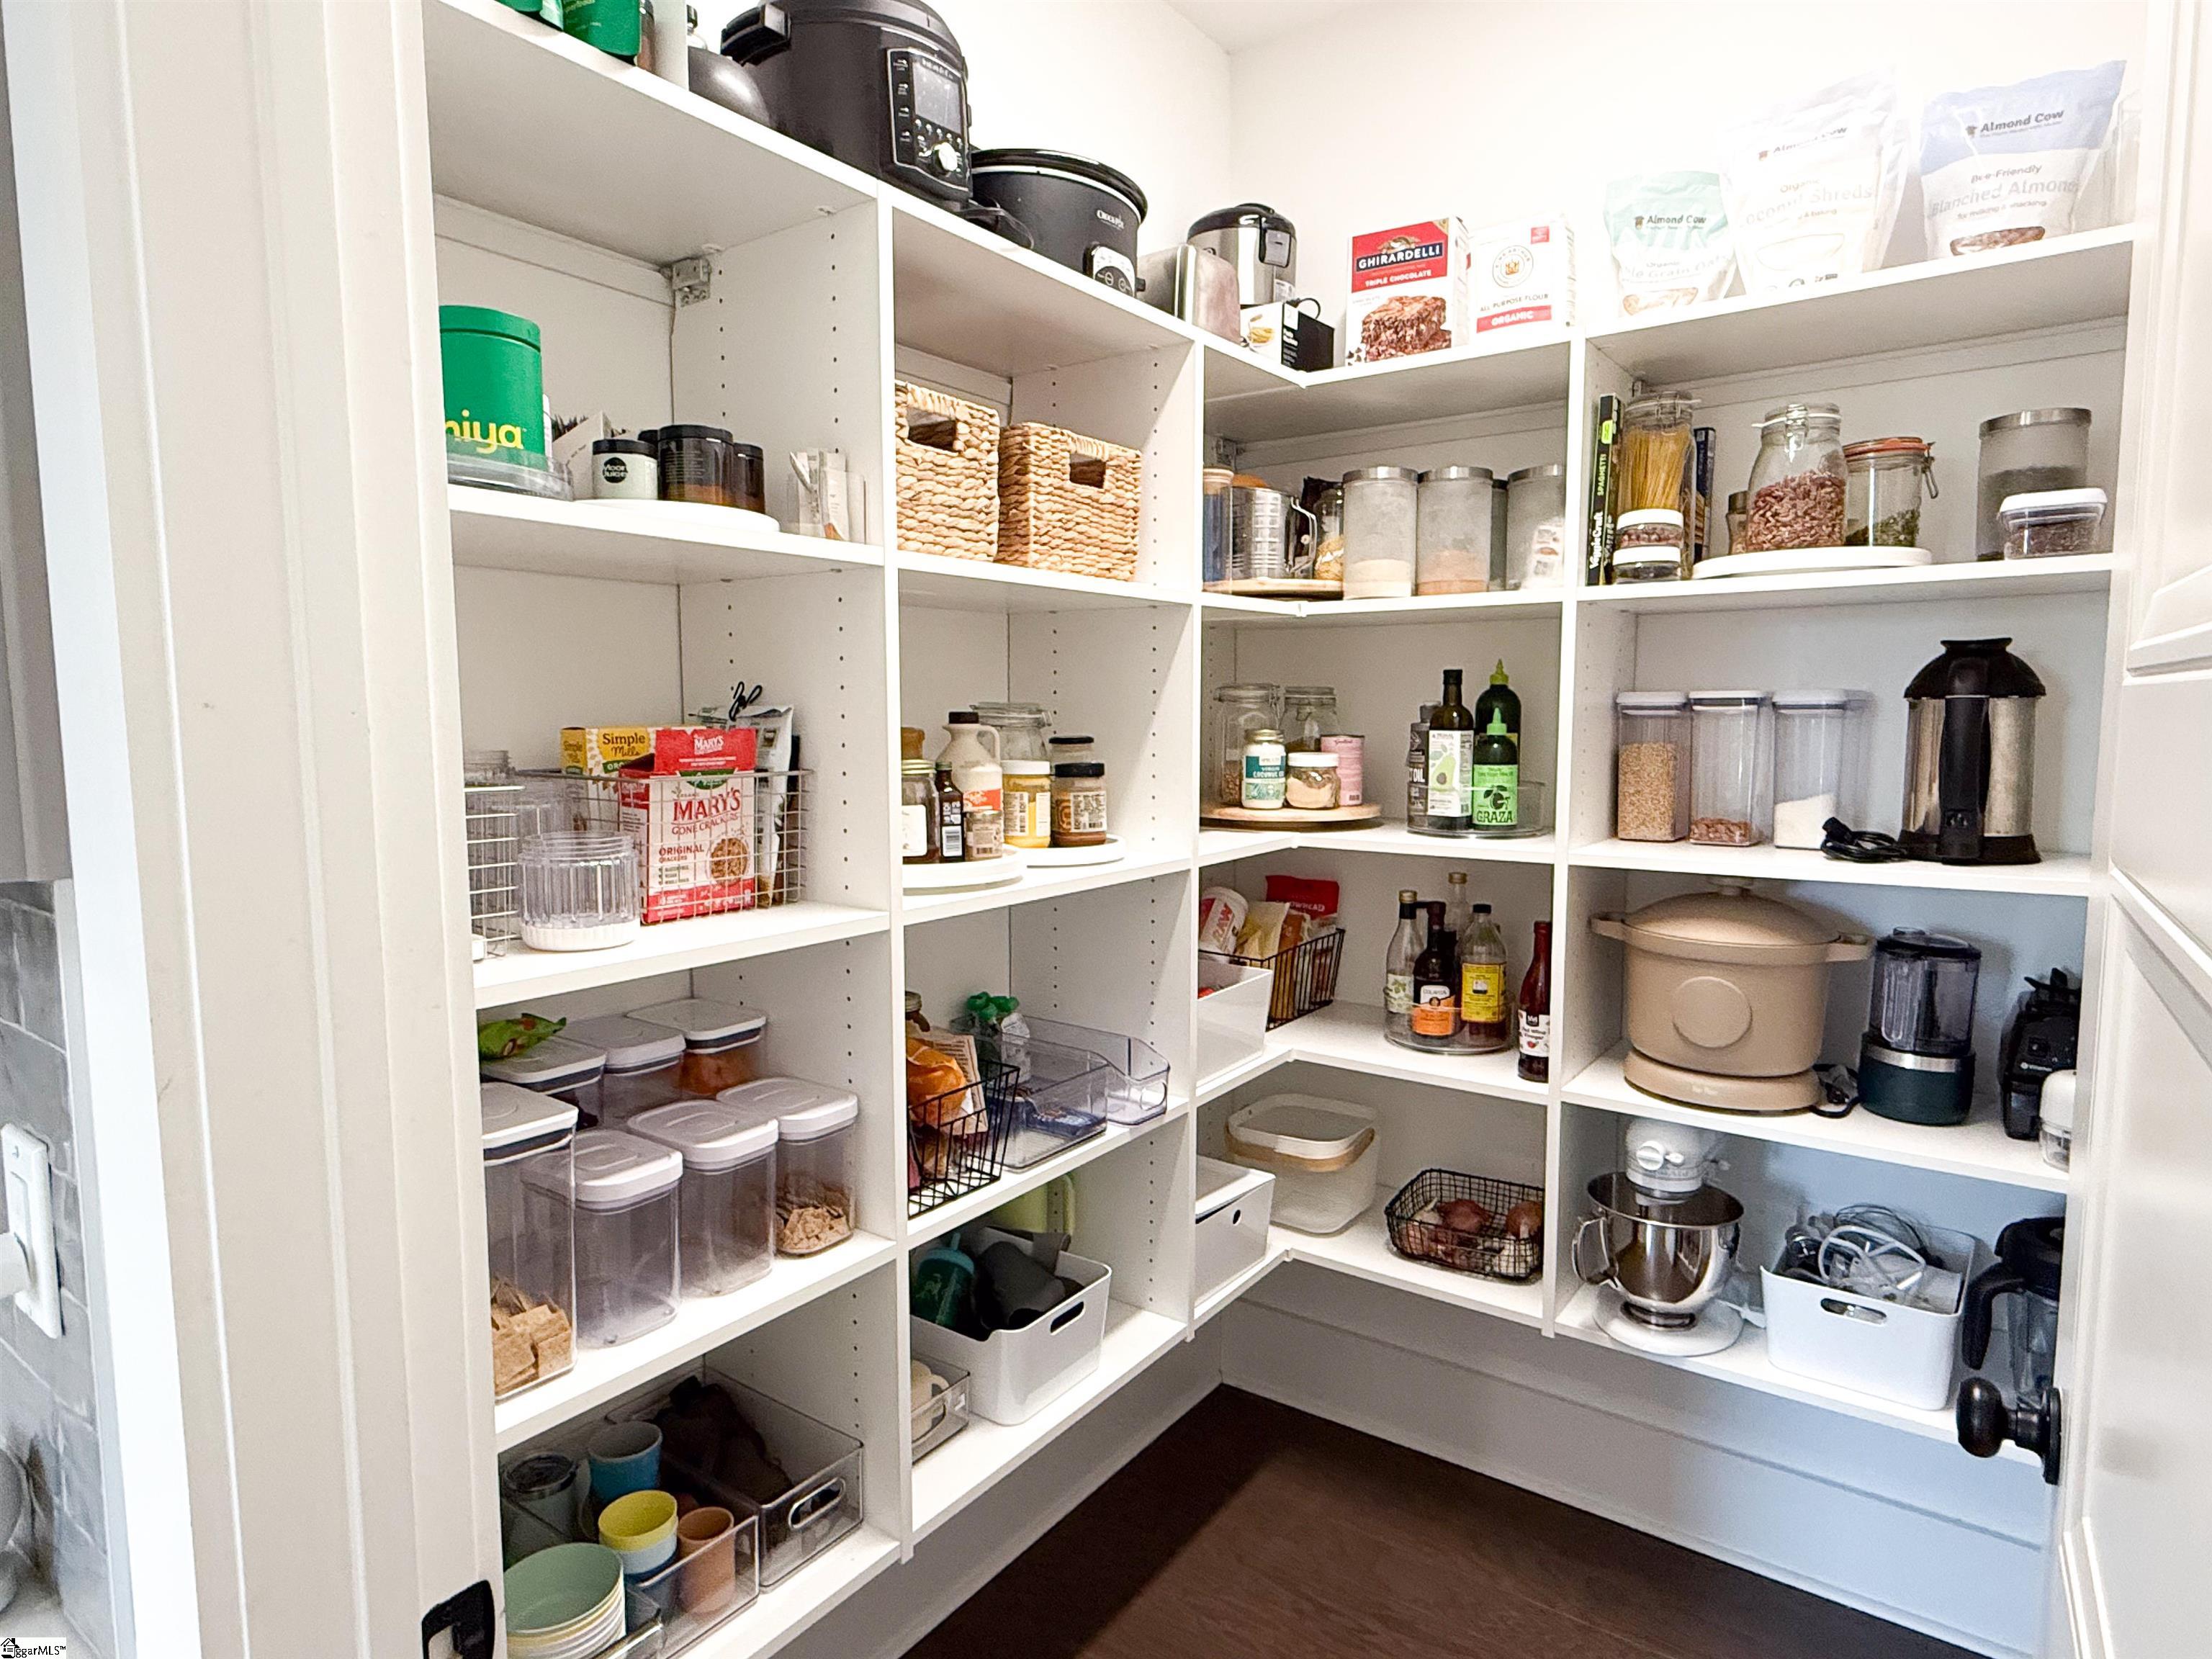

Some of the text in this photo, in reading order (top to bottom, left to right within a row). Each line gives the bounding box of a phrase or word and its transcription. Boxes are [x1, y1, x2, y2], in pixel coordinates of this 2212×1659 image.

[1981, 114, 2031, 132] Almond
[2035, 110, 2064, 123] Cow
[1809, 184, 1872, 203] Shreds
[1930, 182, 2003, 217] Blanched
[1647, 215, 1707, 224] Almond Cow
[1358, 245, 1440, 269] GHIRARDELLI
[1365, 276, 1388, 287] TRIPLE
[1389, 269, 1432, 282] CHOCOLATE
[1493, 297, 1523, 308] PURPOSE
[1491, 310, 1534, 325] ORGANIC
[1597, 454, 1607, 496] SPAGHETTI
[1589, 511, 1604, 570] VeggieCraft
[602, 733, 646, 747] Simple
[610, 746, 641, 757] Mills
[1413, 768, 1426, 783] OIL
[673, 787, 740, 822] MARY'S
[1477, 810, 1514, 823] GRAZA
[672, 824, 697, 835] GONE
[659, 844, 705, 856] ORIGINAL
